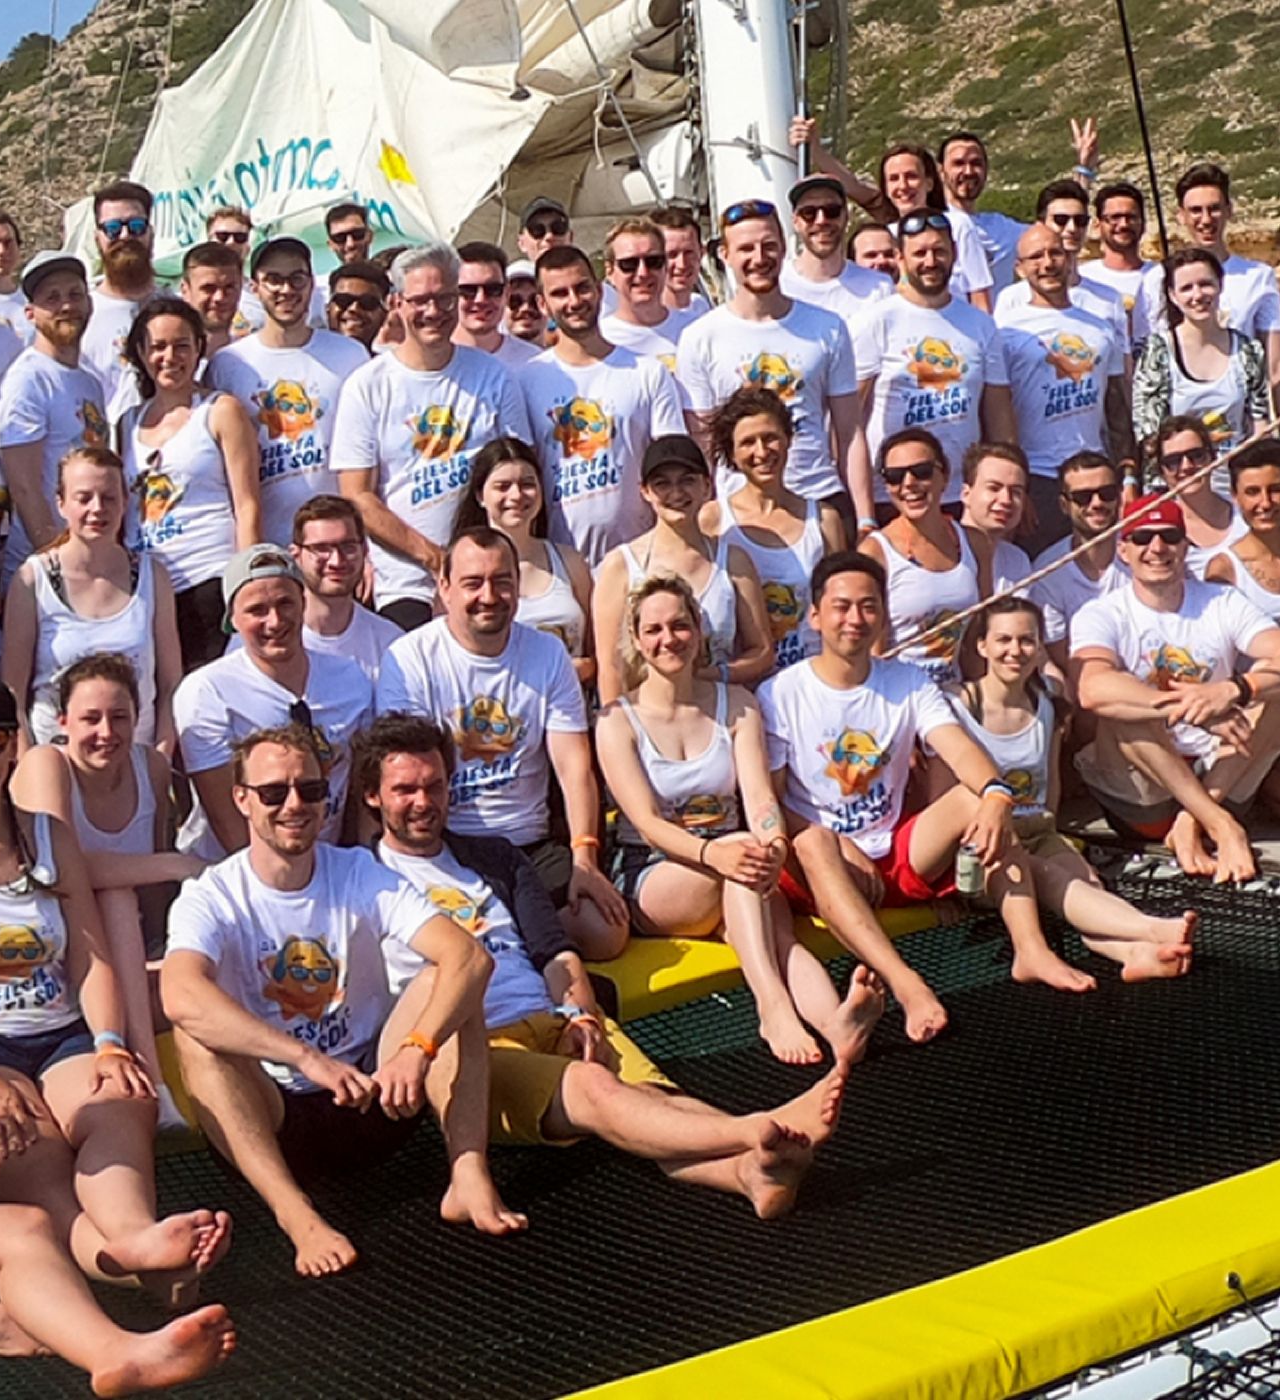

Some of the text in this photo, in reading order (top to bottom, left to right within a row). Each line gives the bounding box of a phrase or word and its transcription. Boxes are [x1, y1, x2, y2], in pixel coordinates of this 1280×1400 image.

[908, 387, 960, 408] FIESTA
[1049, 378, 1094, 401] FIESTA
[905, 404, 936, 426] DEL
[939, 400, 969, 416] SOL
[1045, 396, 1072, 417] DEL
[1074, 390, 1099, 408] SOL
[261, 434, 315, 461] FIESTA
[289, 449, 324, 471] SOL
[414, 452, 469, 483] FIESTA
[558, 454, 609, 480] FIESTA
[411, 479, 443, 505] DEL
[553, 478, 581, 502] DEL
[586, 472, 619, 491] SOL
